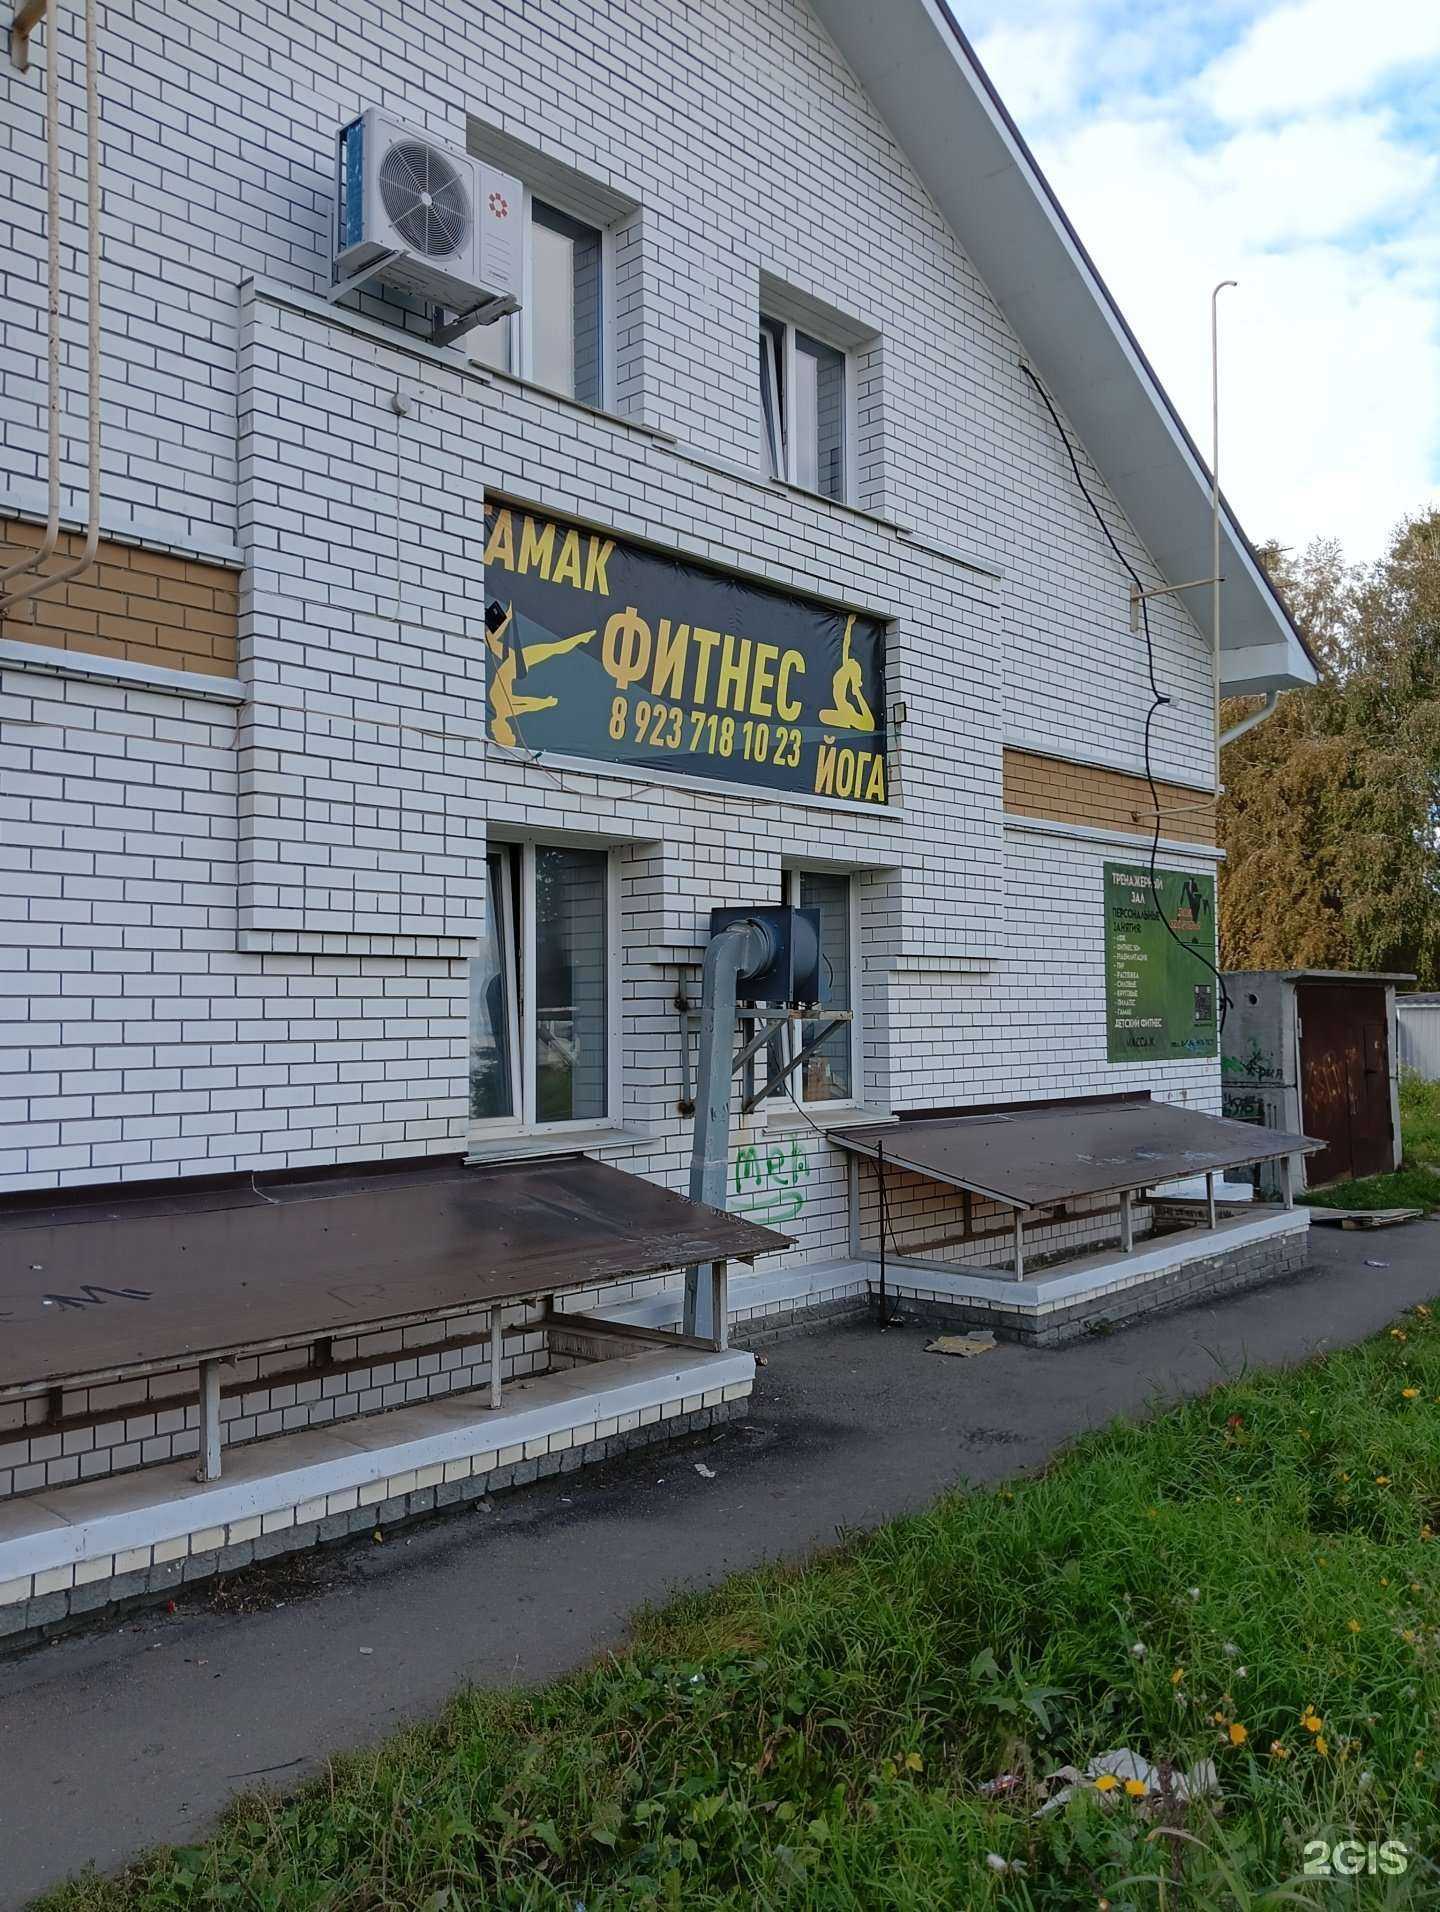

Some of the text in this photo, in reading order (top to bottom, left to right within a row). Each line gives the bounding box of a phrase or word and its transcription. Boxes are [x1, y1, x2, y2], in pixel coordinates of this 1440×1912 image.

[602, 606, 806, 722] ФИТНЕС
[609, 696, 802, 768] 8 923 718 10 23
[814, 734, 886, 802] ЙОГА
[1131, 891, 1145, 904] ЗАЛ
